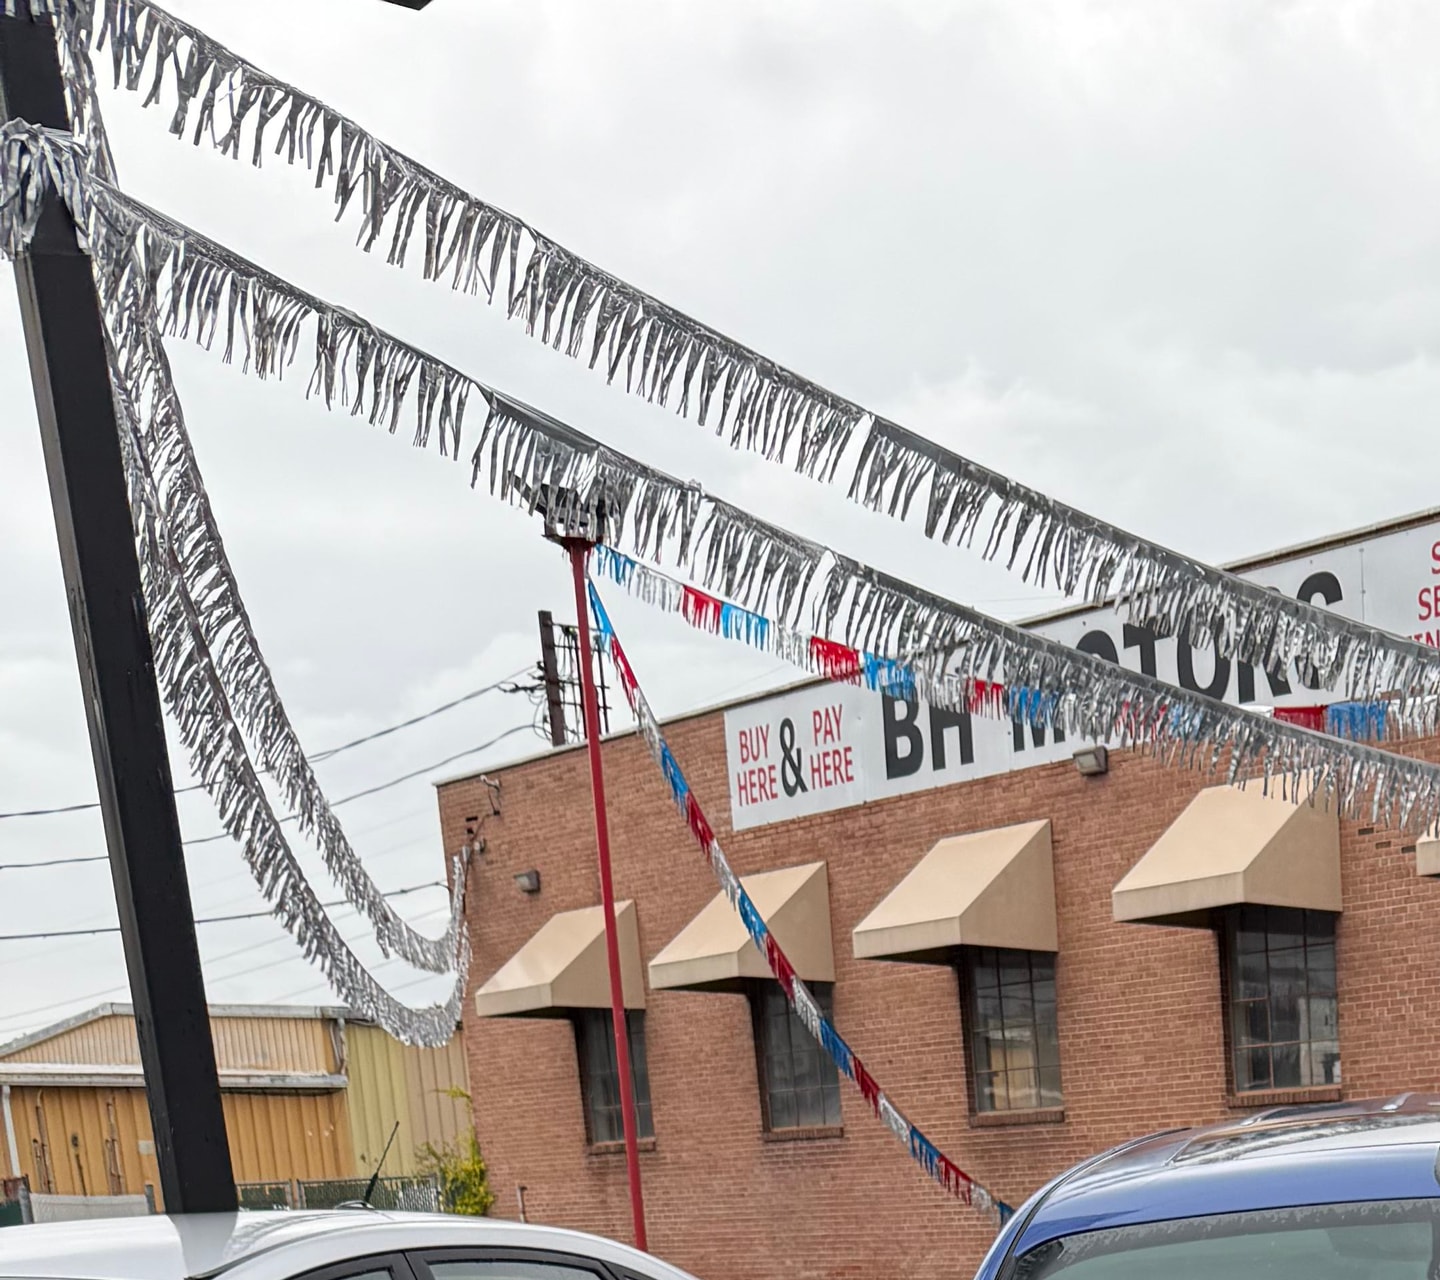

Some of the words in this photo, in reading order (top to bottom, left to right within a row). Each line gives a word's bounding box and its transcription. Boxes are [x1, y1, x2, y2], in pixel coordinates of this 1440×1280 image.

[738, 723, 770, 764] BUY
[812, 704, 843, 747] PAY
[881, 684, 974, 780] BH
[779, 717, 808, 798] &
[811, 746, 854, 790] HERE
[737, 765, 778, 806] HERE
